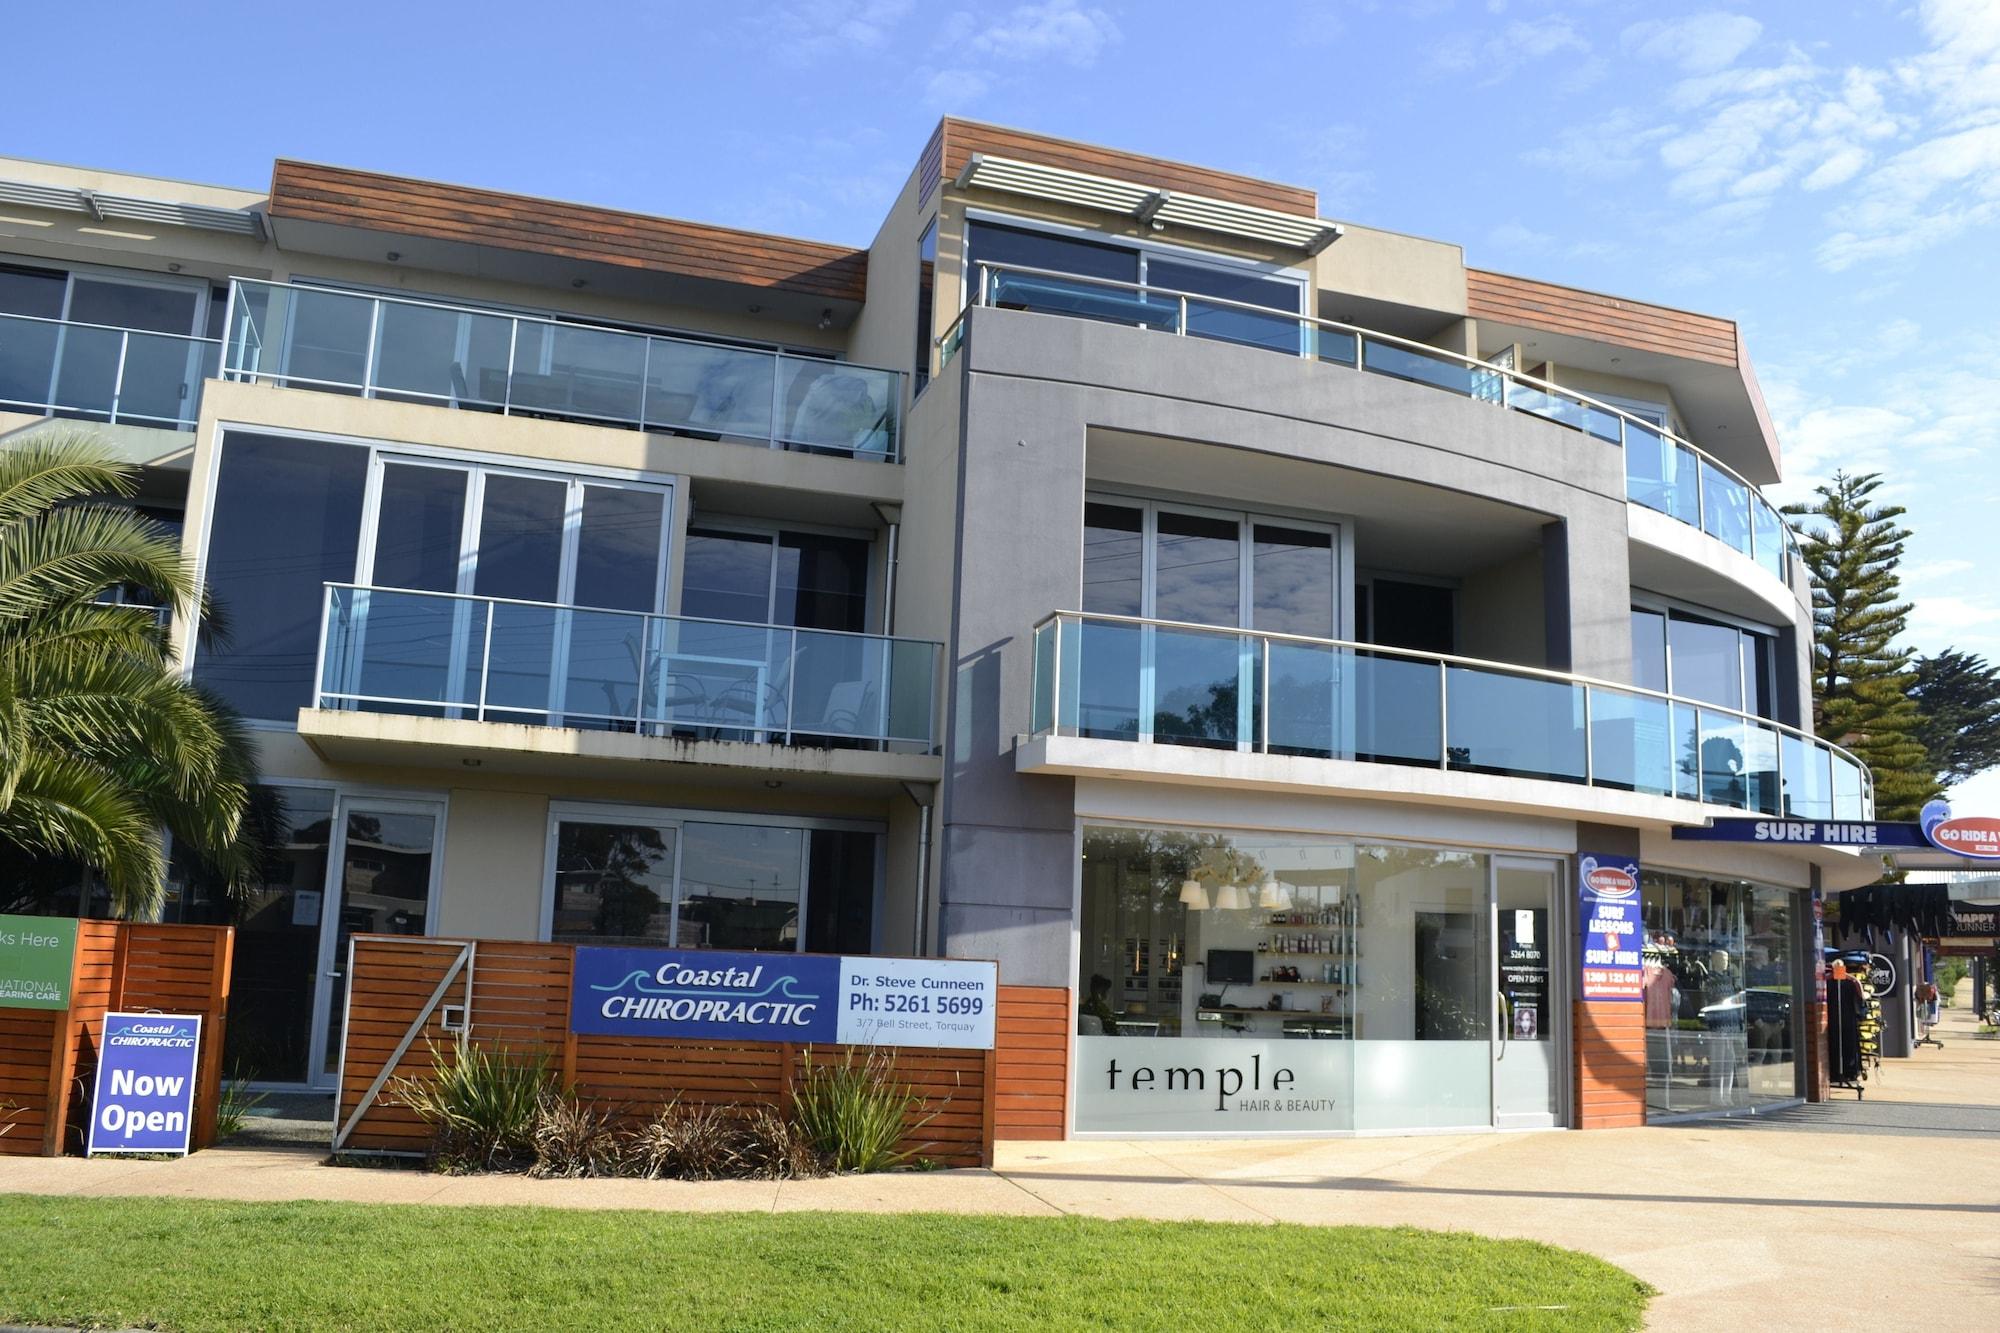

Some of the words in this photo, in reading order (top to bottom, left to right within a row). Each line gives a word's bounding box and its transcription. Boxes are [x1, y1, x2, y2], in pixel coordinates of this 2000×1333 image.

[1755, 822, 1816, 841] SURF
[1824, 823, 1877, 843] HIRE
[1940, 829, 1960, 840] GO
[1961, 830, 1987, 842] RIDE
[1988, 831, 1997, 842] A
[1598, 905, 1624, 920] SURF
[1954, 913, 1994, 923] HAPPY
[1589, 919, 1635, 935] LESSONS
[21, 932, 59, 948] Here
[1585, 949, 1613, 964] SURF
[1615, 951, 1639, 966] HIRE
[656, 962, 763, 988] Coastal
[851, 975, 870, 987] Dr.
[875, 975, 916, 988] Steve
[921, 977, 984, 991] Cunneen
[1508, 974, 1525, 983] OPEN
[1530, 975, 1544, 983] DAYS
[35, 992, 61, 1001] CARE
[850, 993, 879, 1011] Ph:
[884, 994, 930, 1013] 5261
[936, 996, 983, 1015] 5699
[601, 996, 817, 1026] CHIROPRACTIC
[132, 1024, 174, 1034] Coastal
[856, 1018, 873, 1029] 3/7
[877, 1019, 895, 1029] Bell
[898, 1020, 932, 1031] Street,
[936, 1021, 975, 1033] Torquay
[110, 1036, 194, 1048] CHIROPRACTIC
[110, 1069, 185, 1097] Now
[1106, 1054, 1295, 1111] temple
[1240, 1100, 1270, 1112] HAIR
[1274, 1100, 1283, 1111] &
[1288, 1100, 1336, 1112] BEAUTY
[101, 1104, 184, 1139] Open
